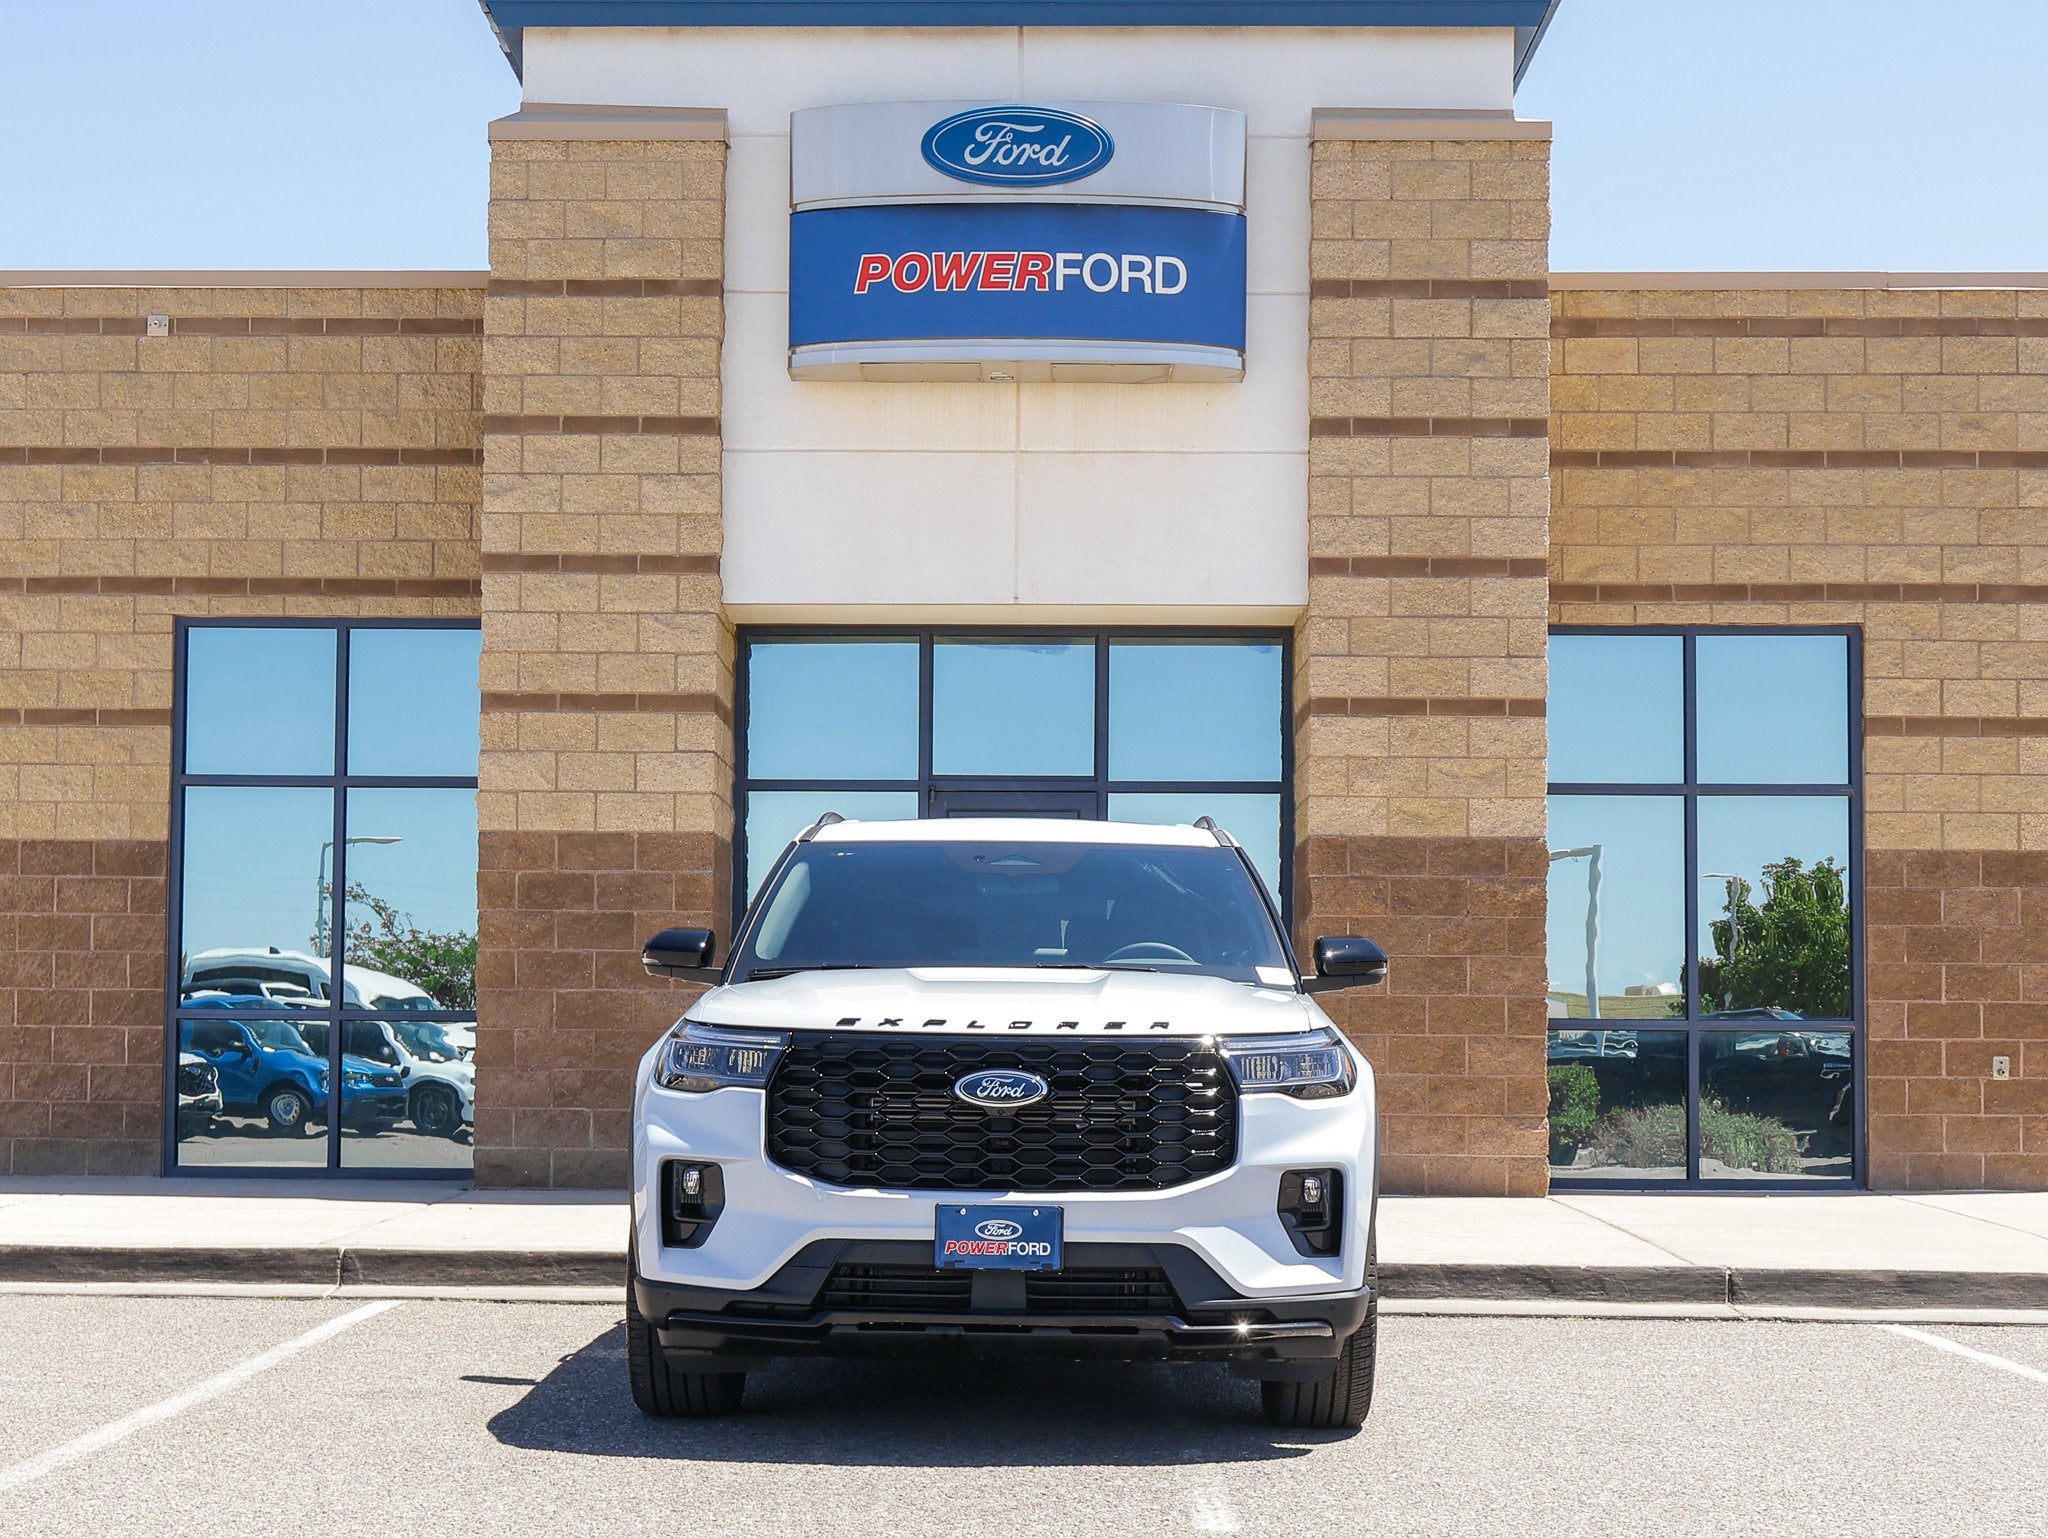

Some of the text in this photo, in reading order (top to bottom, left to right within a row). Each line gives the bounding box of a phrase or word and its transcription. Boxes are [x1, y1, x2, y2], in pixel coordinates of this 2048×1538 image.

[964, 122, 1071, 166] Ford
[854, 251, 1187, 295] POWERFORD
[835, 1017, 1170, 1030] EXPLORER
[976, 1078, 1025, 1098] Ford
[984, 1223, 1013, 1236] Ford
[944, 1240, 1051, 1256] POWERFORD
